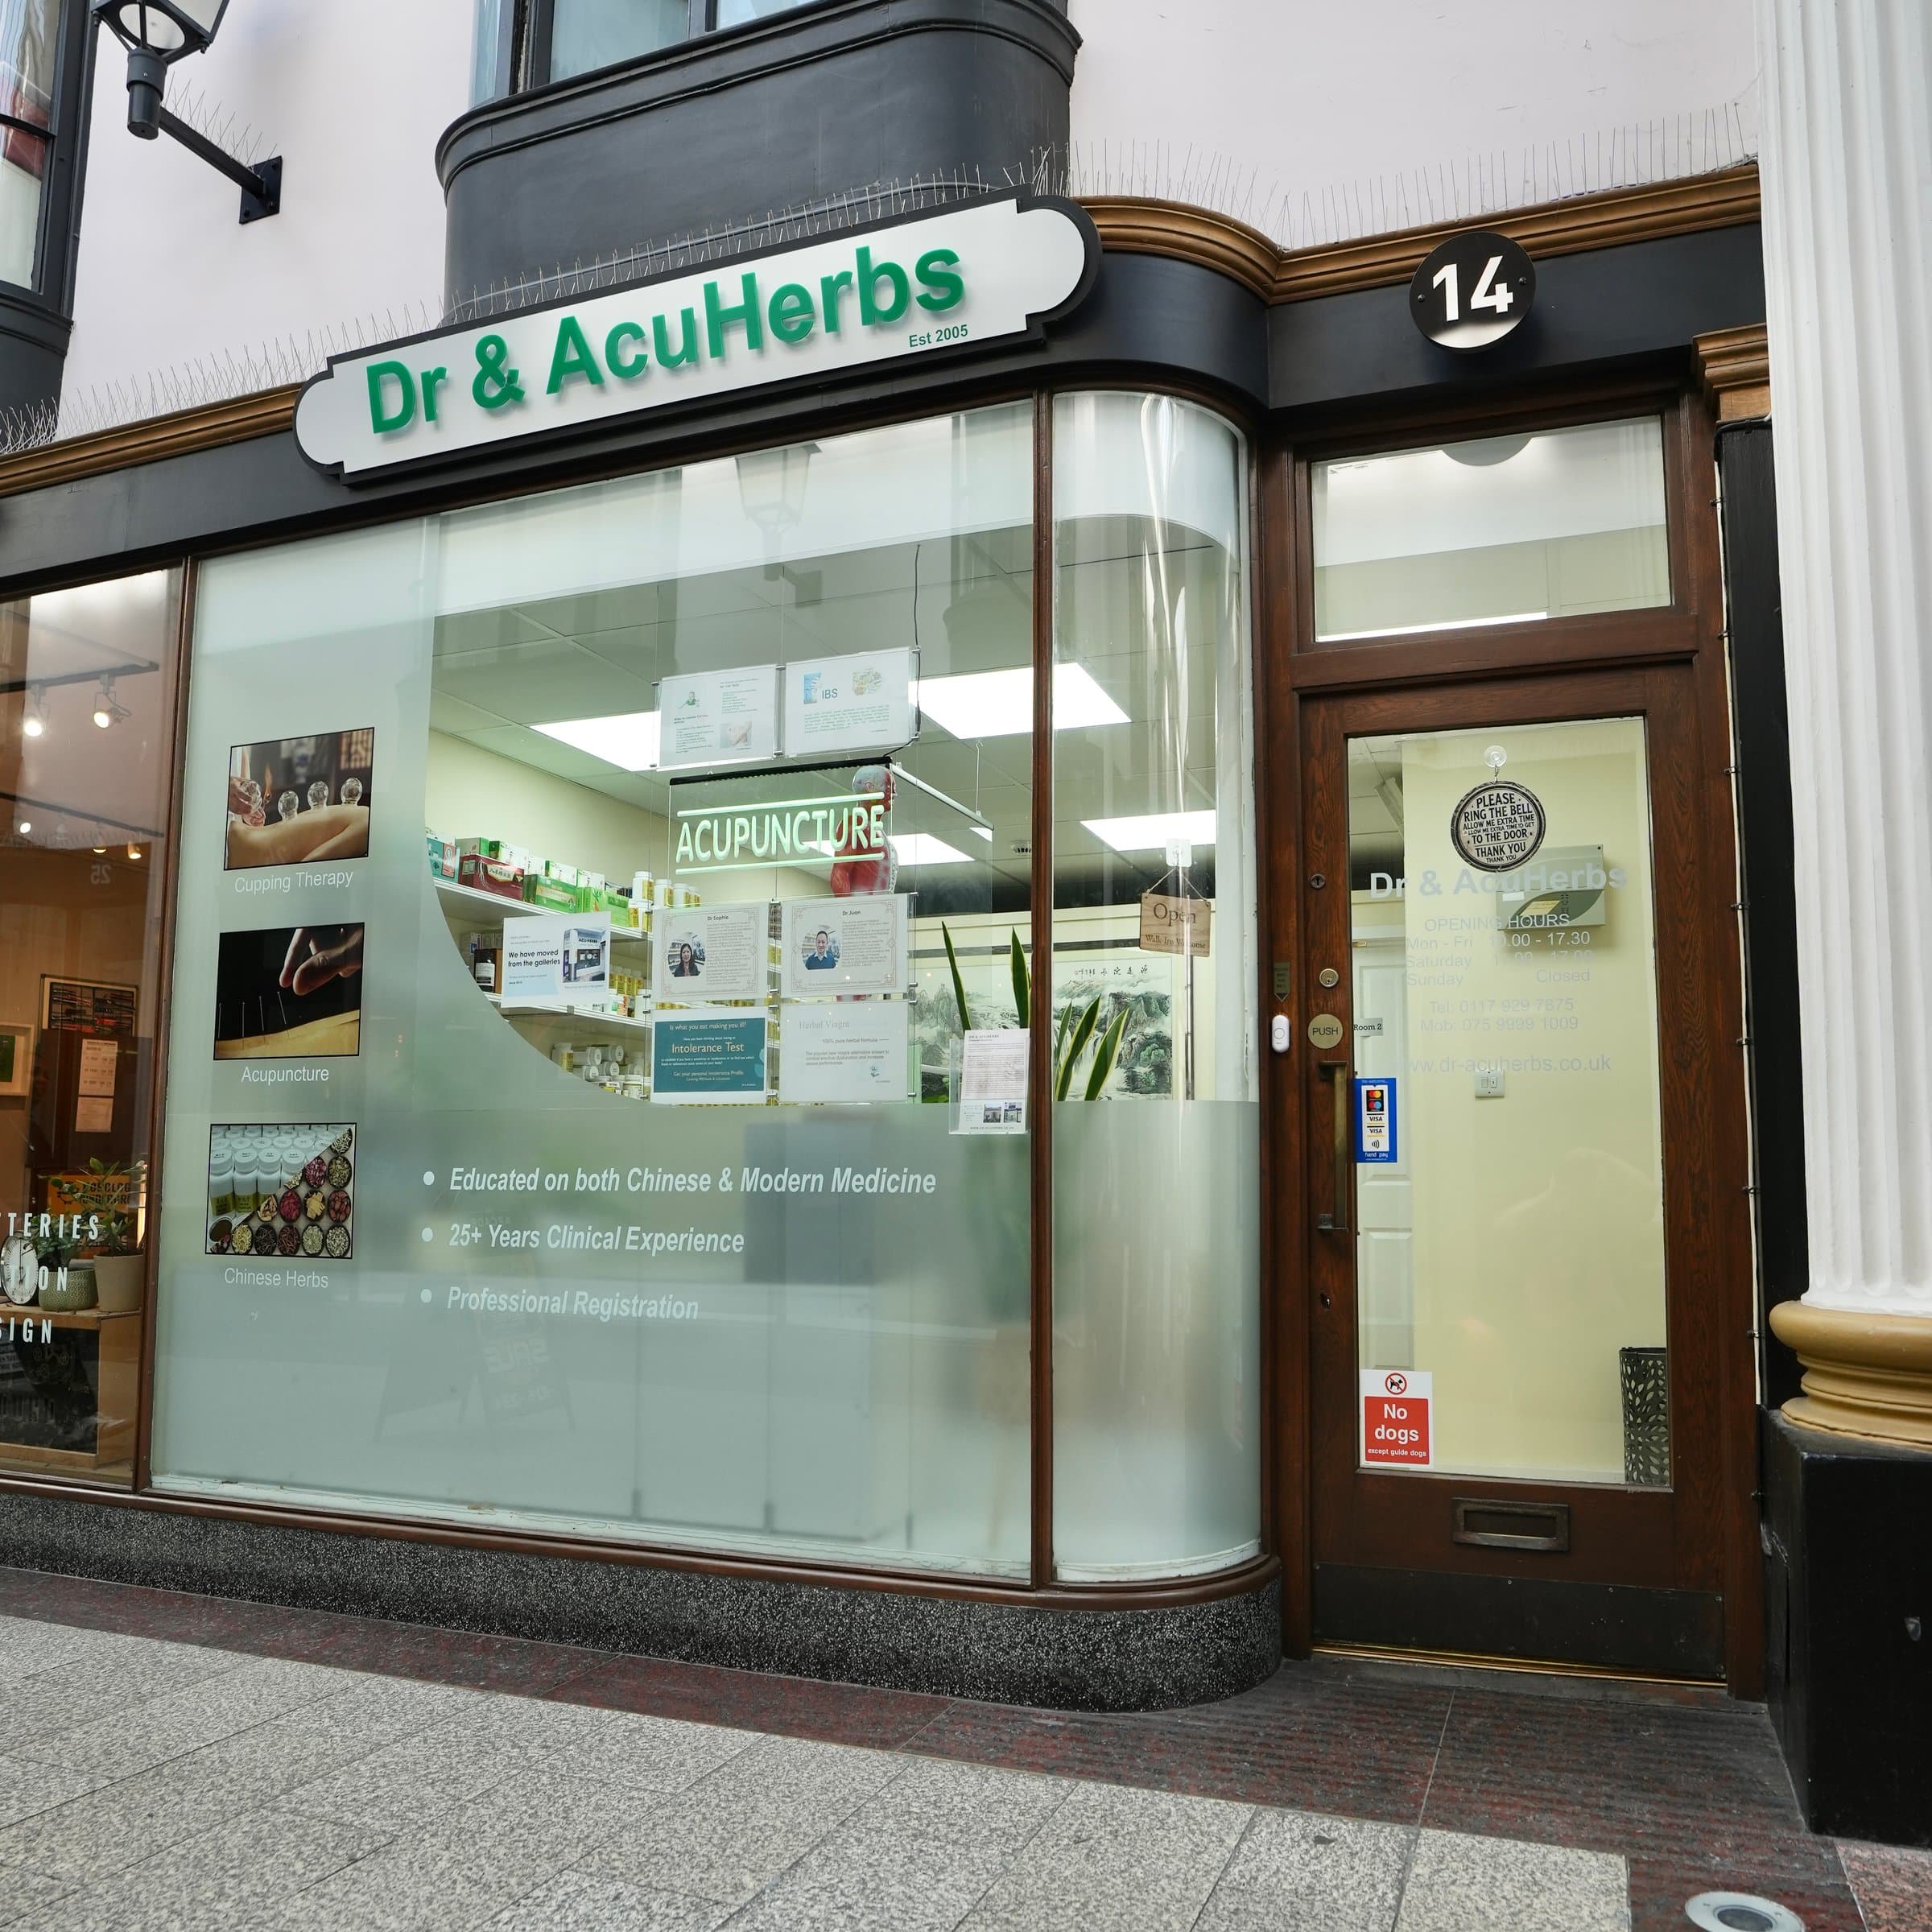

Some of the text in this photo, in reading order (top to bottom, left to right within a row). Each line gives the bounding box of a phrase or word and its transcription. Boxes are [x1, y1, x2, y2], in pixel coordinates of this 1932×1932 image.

[1433, 255, 1513, 322] 14
[365, 246, 964, 434] Dr & AcuHerbs
[909, 324, 968, 348] Est 2005
[822, 688, 838, 700] IBS
[1476, 793, 1515, 808] PLEASE
[1463, 814, 1535, 830] ALLOW ME EXTRA TIME
[1464, 803, 1532, 822] RING THE BELL
[676, 805, 885, 863] ACUPUNCTURE
[1472, 829, 1527, 844] TO THE DOOR
[1475, 842, 1526, 857] THANK YOU
[235, 870, 353, 895] Cupping Therapy
[1370, 863, 1628, 899] Dr & AcuHerbs
[1154, 903, 1196, 927] Open
[1425, 914, 1570, 932] OPENING HOURS
[1407, 938, 1438, 950] Mon
[1455, 936, 1472, 947] Fri
[1548, 932, 1590, 945] 17.30
[536, 948, 559, 956] moved
[1406, 954, 1472, 968] Saturday
[535, 958, 560, 968] galleries
[1407, 968, 1591, 988] Sunday Closed
[1460, 1000, 1495, 1013] 0117
[1313, 1027, 1338, 1035] PUSH
[1420, 1018, 1456, 1031] Mob:
[671, 1042, 745, 1054] Intolerance Test
[1402, 1054, 1611, 1072] ww.dr-acuherbs.co.uk
[242, 1066, 329, 1086] Acupuncture
[450, 1167, 937, 1193] Educated on both Chinese & Modern Medicine
[0, 1212, 99, 1241] TERIES
[449, 1224, 745, 1257] 25+ Years Clinical Experience
[0, 1265, 68, 1292] TION
[225, 1267, 328, 1288] Chinese Herbs
[448, 1286, 699, 1322] Professional Registration
[0, 1317, 52, 1344] IGN
[1384, 1403, 1407, 1419] No
[1375, 1424, 1419, 1444] dogs
[1410, 1449, 1426, 1458] dogs
